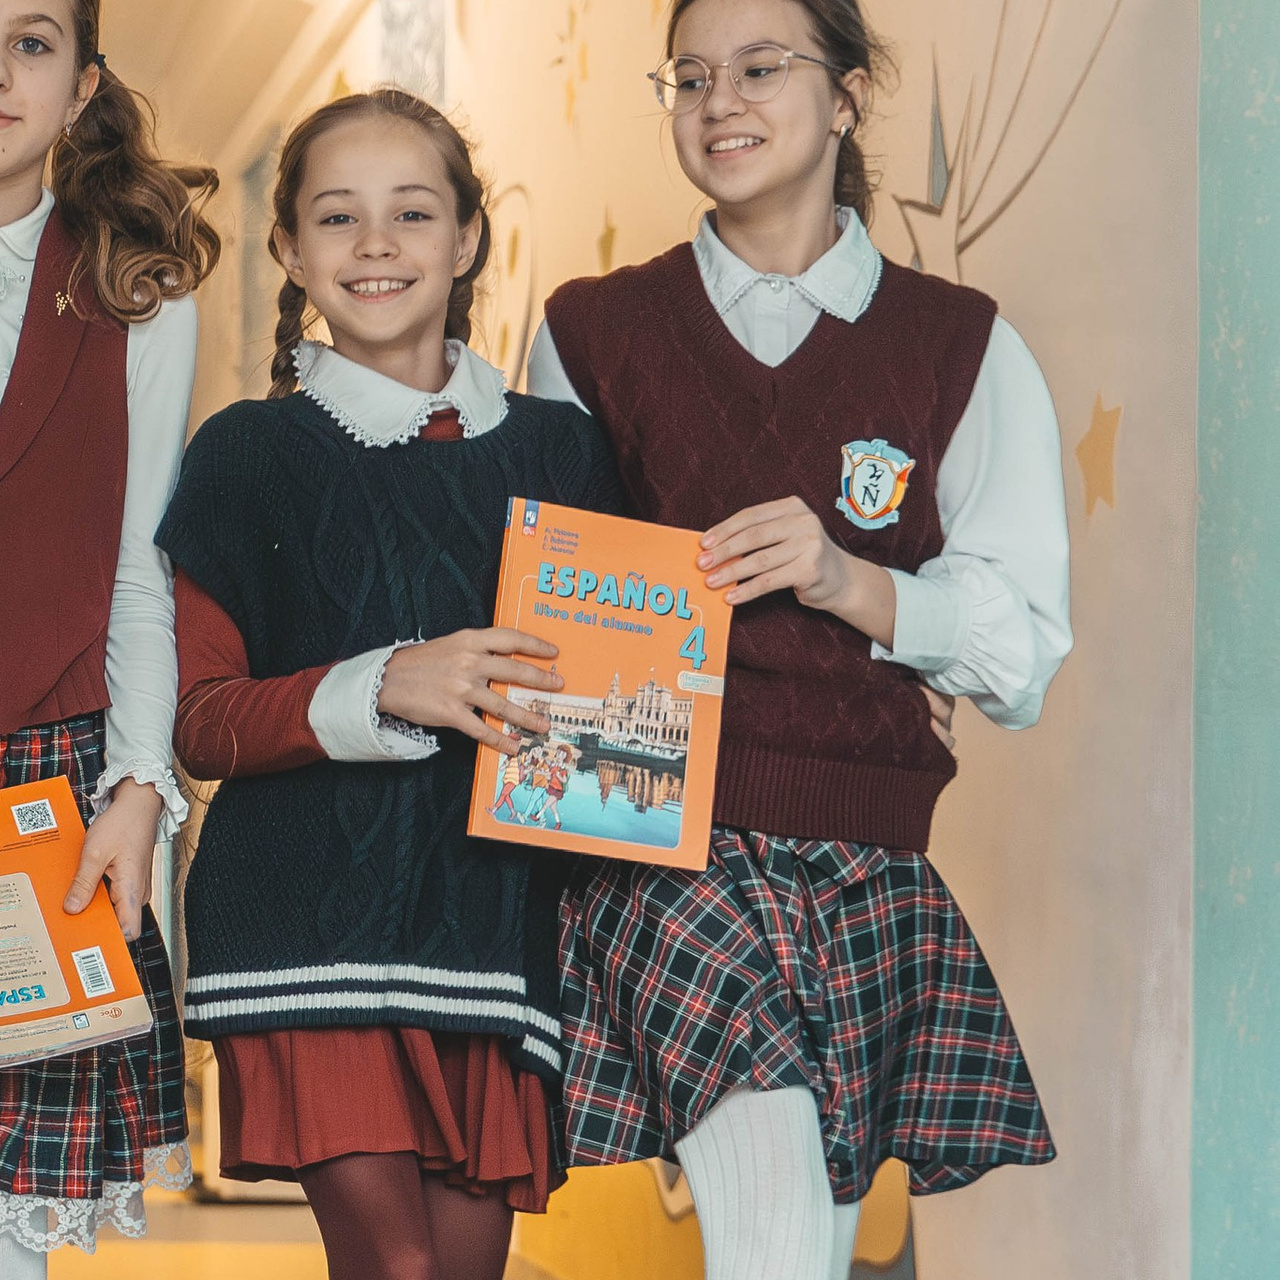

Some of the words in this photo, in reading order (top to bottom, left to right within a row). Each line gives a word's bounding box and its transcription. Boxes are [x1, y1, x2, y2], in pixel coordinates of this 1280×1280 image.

[861, 483, 881, 508] Ñ
[536, 561, 693, 620] ESPAÑOL
[533, 602, 570, 621] libro
[573, 609, 598, 626] del
[601, 615, 653, 636] alumno
[678, 625, 707, 670] 4
